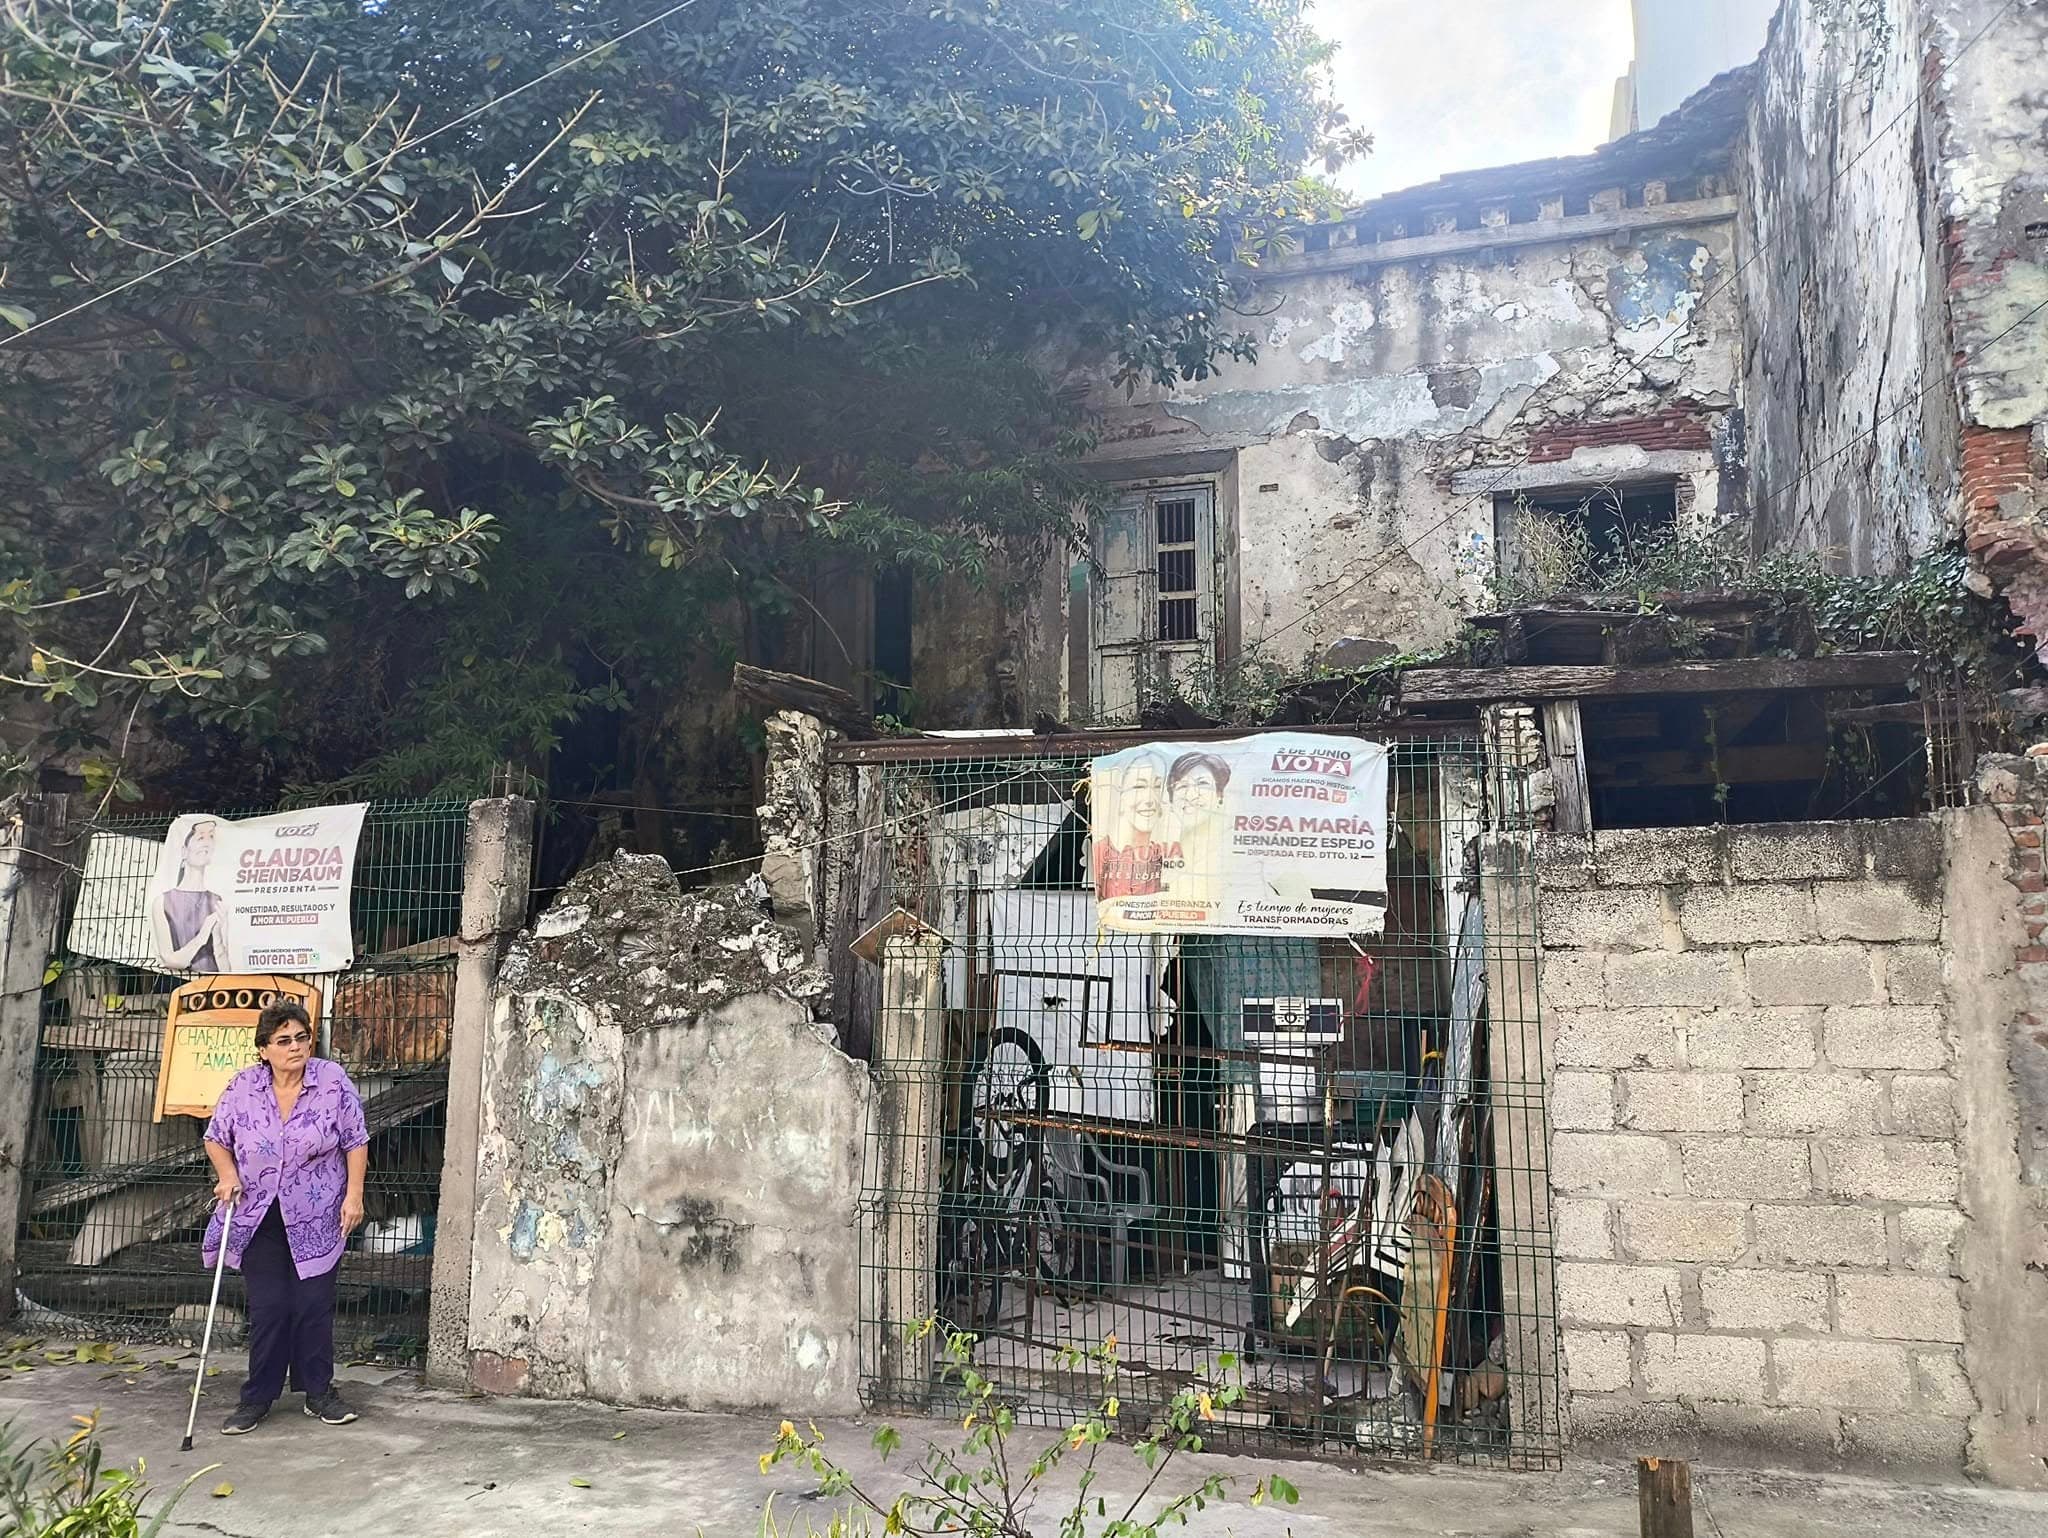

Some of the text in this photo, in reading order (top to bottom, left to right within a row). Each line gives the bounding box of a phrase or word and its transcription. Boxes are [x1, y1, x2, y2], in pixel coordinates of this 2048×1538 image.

[1309, 749, 1351, 760] JUNIO
[1276, 755, 1348, 777] VOTA
[1251, 784, 1329, 801] morena
[276, 823, 319, 837] VOTA
[1234, 814, 1375, 836] ROSA MARÍA
[1233, 833, 1375, 850] HERNÁNDEZ ESPEJO
[240, 846, 343, 868] CLAUDIA
[1247, 849, 1294, 858] DIPUTADA
[1296, 851, 1317, 859] FED.
[1319, 852, 1347, 860] DTTO.
[236, 866, 342, 884] SHEINBAUM
[254, 885, 316, 894] PRESIDENTA
[235, 903, 336, 914] HONESTIDAD, RESULTADOS Y
[1214, 901, 1221, 910] Y
[1238, 900, 1353, 917] Es tiempo de mujeres
[252, 914, 316, 925] AMOR AL PUEBLO
[1243, 915, 1349, 925] TRANSFORMADORAS
[248, 953, 295, 966] morena
